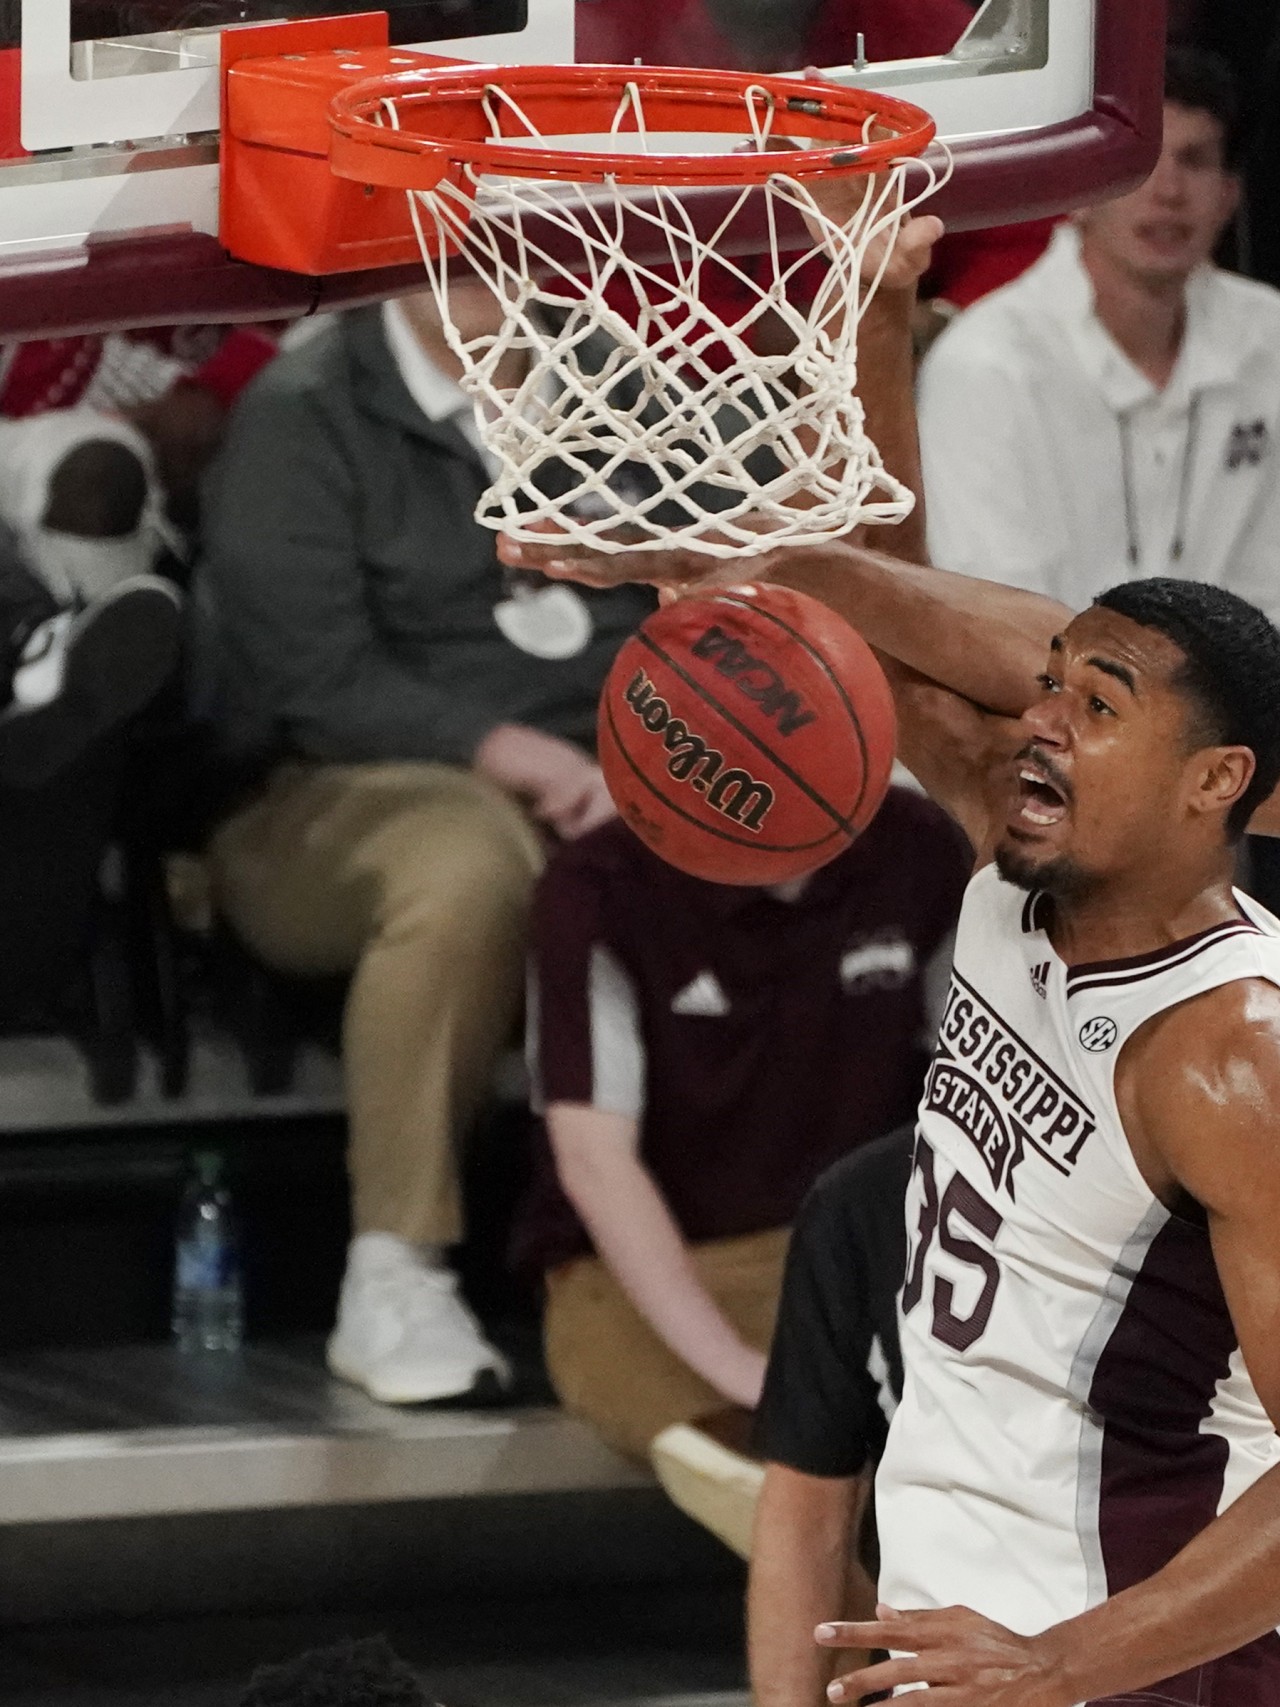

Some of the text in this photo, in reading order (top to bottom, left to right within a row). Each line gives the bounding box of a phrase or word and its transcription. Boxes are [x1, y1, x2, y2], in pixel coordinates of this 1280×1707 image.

[623, 666, 776, 834] Wilson
[691, 625, 817, 737] NCAA
[941, 978, 1097, 1166] ISSISSIPPI
[1079, 1016, 1118, 1053] SEC
[932, 1070, 1006, 1171] STATE
[901, 1134, 1004, 1353] 35
